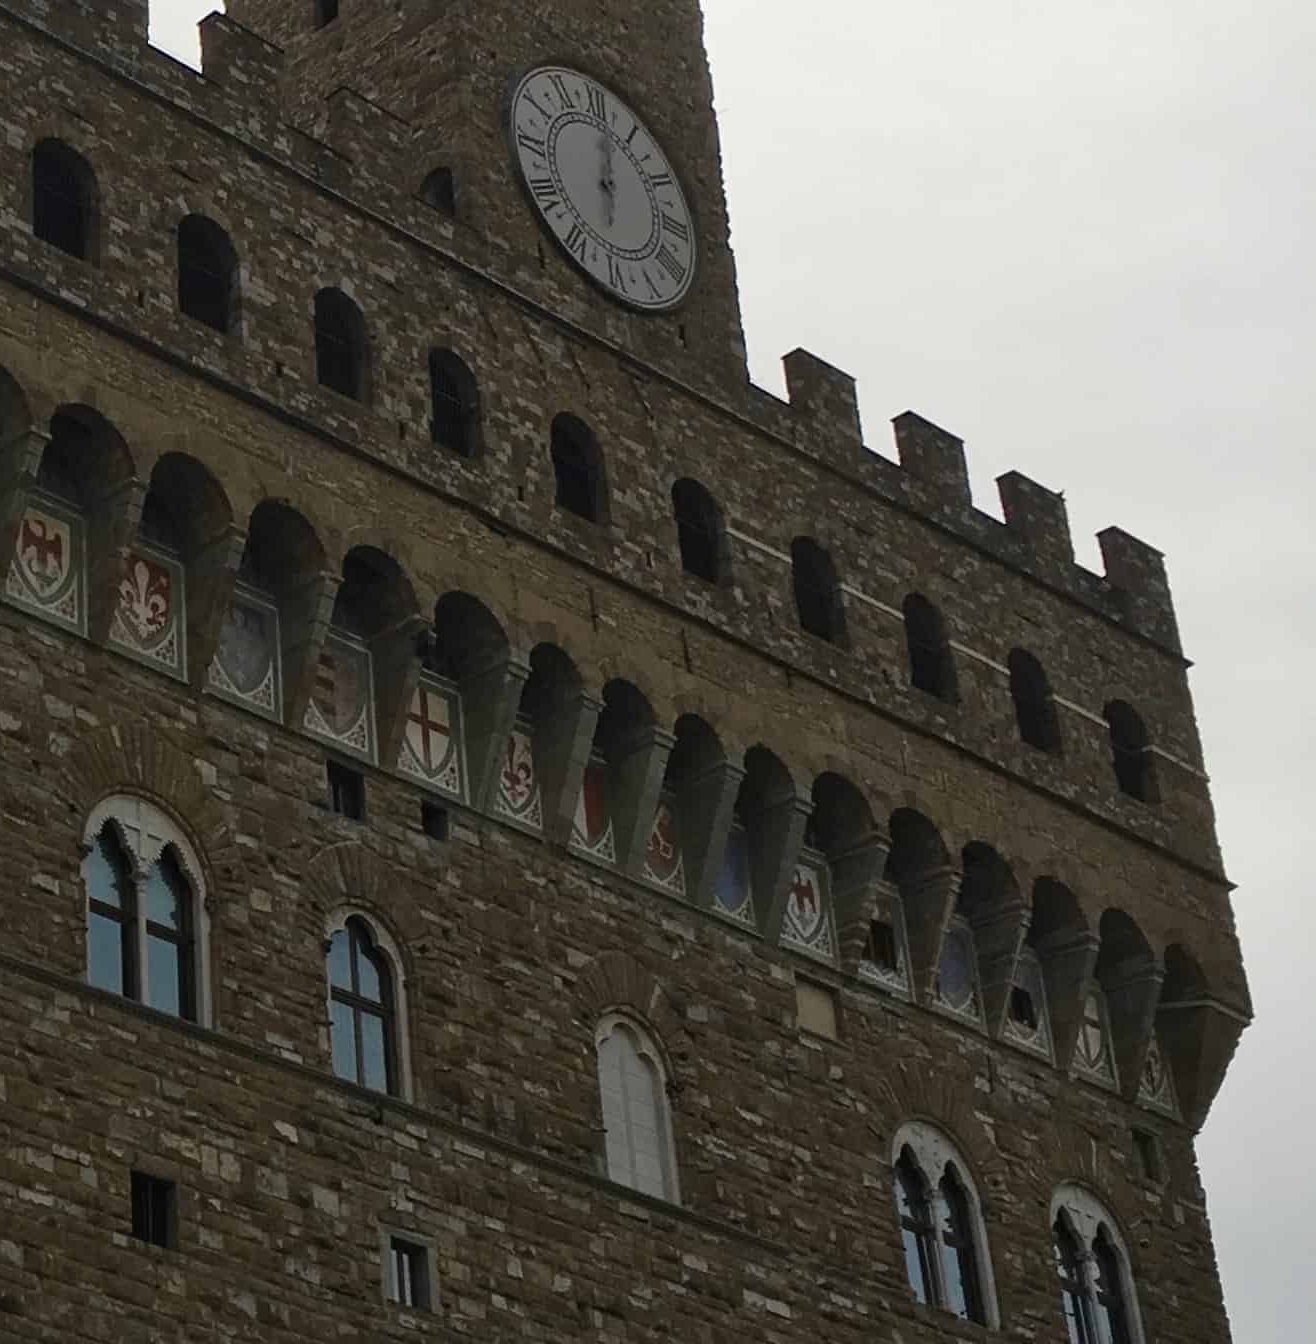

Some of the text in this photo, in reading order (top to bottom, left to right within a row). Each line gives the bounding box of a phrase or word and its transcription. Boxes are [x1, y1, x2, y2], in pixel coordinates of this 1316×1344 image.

[584, 79, 607, 122] XII
[625, 125, 639, 145] I
[529, 177, 561, 213] VIII
[647, 171, 673, 190] II
[564, 222, 588, 262] VII
[661, 209, 689, 243] III
[605, 253, 629, 294] VI
